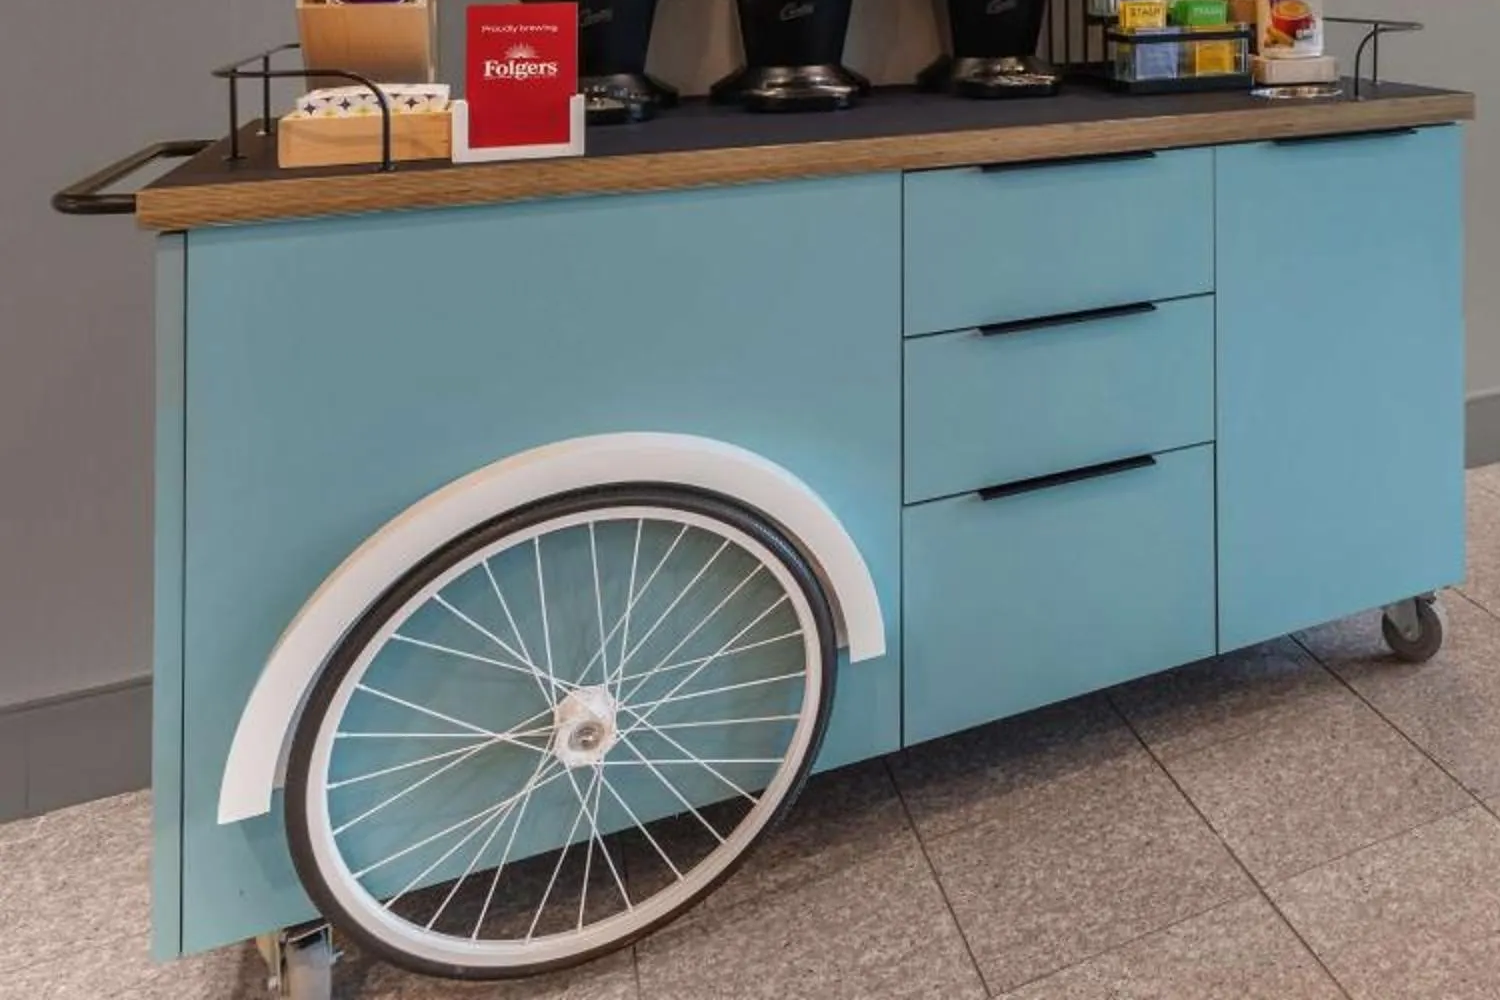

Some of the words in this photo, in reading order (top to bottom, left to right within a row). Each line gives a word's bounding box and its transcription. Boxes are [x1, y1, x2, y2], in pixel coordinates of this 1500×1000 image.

[481, 24, 517, 33] Proudly
[519, 23, 558, 33] brewing
[483, 59, 558, 81] Folgers
